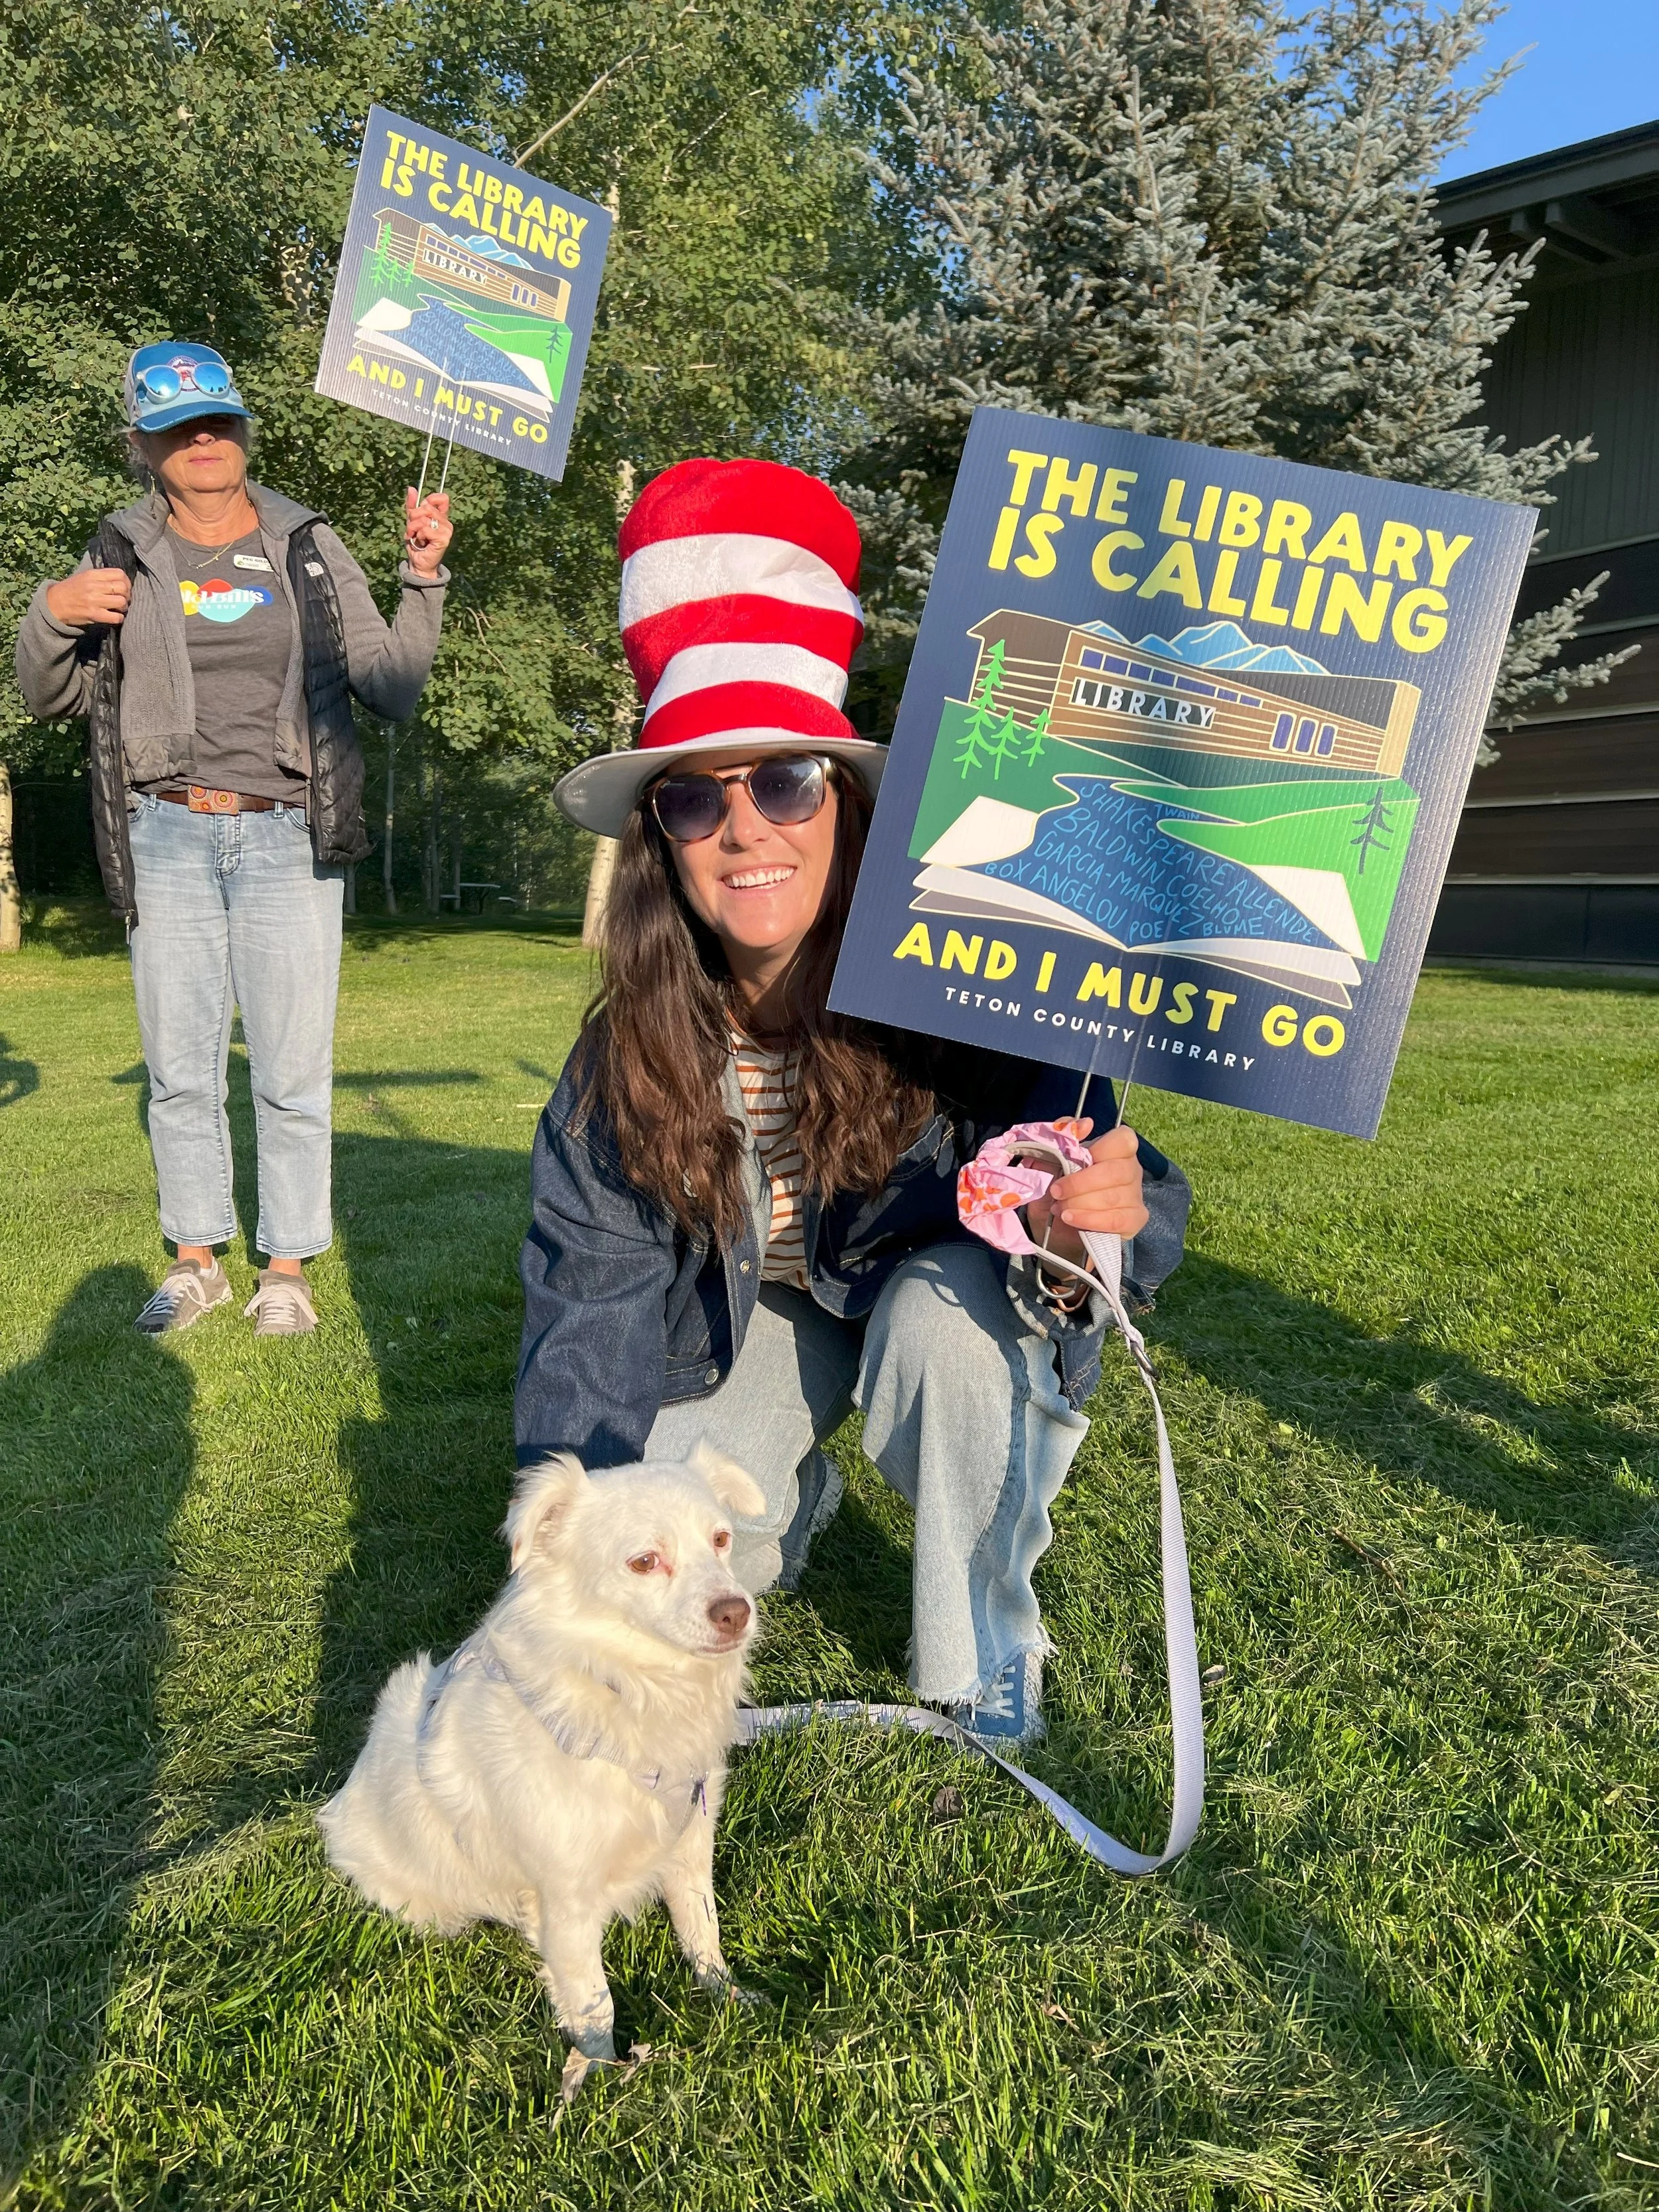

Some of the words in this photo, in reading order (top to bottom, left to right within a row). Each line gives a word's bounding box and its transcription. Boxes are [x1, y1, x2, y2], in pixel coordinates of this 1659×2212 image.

[380, 157, 416, 197] IS
[428, 184, 581, 268] CALLING
[386, 130, 449, 179] THE
[457, 163, 589, 242] LIBRARY
[423, 248, 488, 285] LIBRARY
[345, 354, 407, 390] AND
[415, 376, 425, 398] I
[433, 386, 504, 427] MUST
[512, 415, 549, 444] GO
[372, 388, 409, 408] TETON
[414, 405, 461, 427] COUNTY
[465, 423, 512, 447] LIBRARY
[1007, 449, 1139, 526] THE
[1158, 479, 1474, 588] LIBRARY
[988, 508, 1066, 579] IS
[1092, 530, 1449, 654] CALLING
[1074, 680, 1216, 727] LIBRARY
[1079, 783, 1236, 887] SHAKESPEARE
[1227, 879, 1319, 943] ALLENDE
[1154, 804, 1201, 820] TWAIN
[984, 859, 1032, 882] BOX
[1029, 864, 1128, 930] ANGELOU
[1129, 921, 1165, 942] POE
[1202, 916, 1265, 937] BLUME
[1033, 830, 1205, 936] GARCIA-MARQUEZ
[1053, 807, 1166, 883] BALDWIN
[1166, 875, 1242, 925] COELHO
[893, 922, 1017, 981] AND
[1035, 952, 1057, 993] I
[1076, 961, 1238, 1033] MUST
[1262, 1004, 1346, 1057] GO
[944, 986, 1021, 1017] TETON
[1033, 1007, 1136, 1044] COUNTY
[1147, 1034, 1257, 1071] LIBRARY
